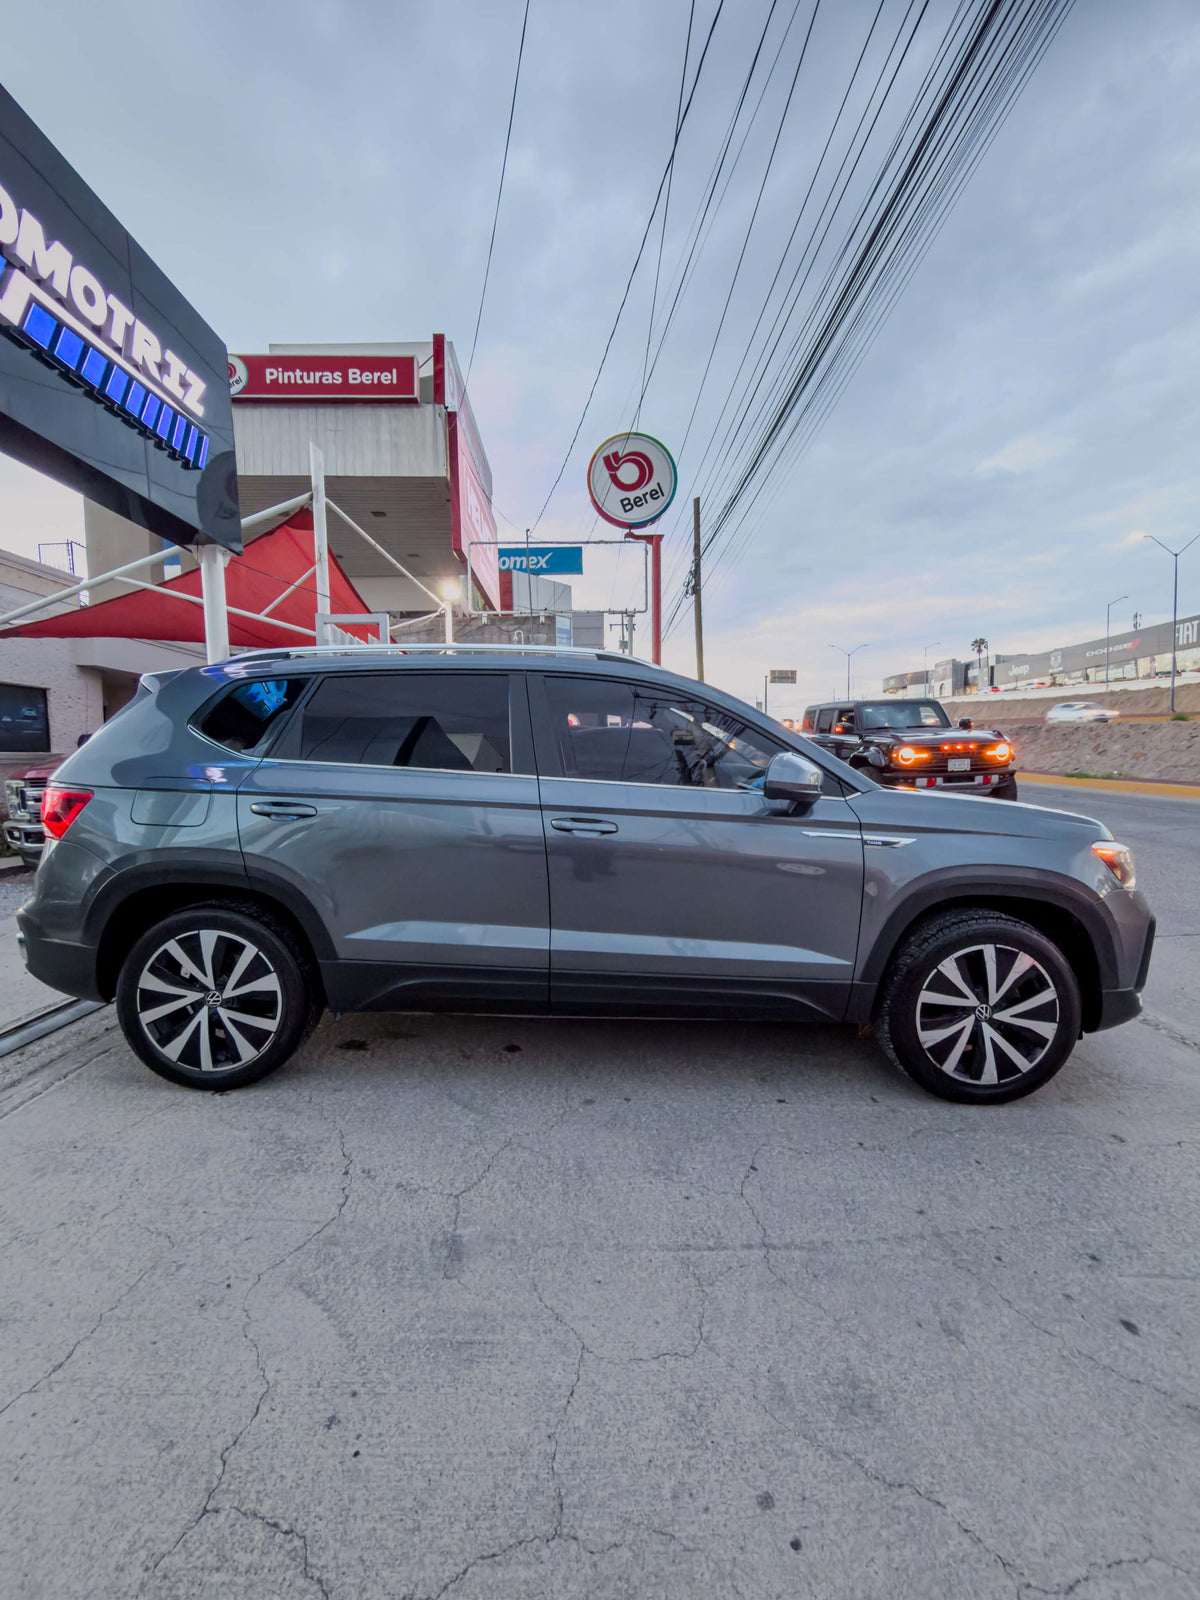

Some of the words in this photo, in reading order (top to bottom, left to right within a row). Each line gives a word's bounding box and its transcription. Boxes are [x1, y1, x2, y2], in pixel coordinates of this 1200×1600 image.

[265, 368, 342, 385] Pinturas
[348, 368, 398, 385] Berel
[620, 482, 665, 513] Berel
[498, 552, 553, 569] omex
[1008, 664, 1030, 676] Jeep
